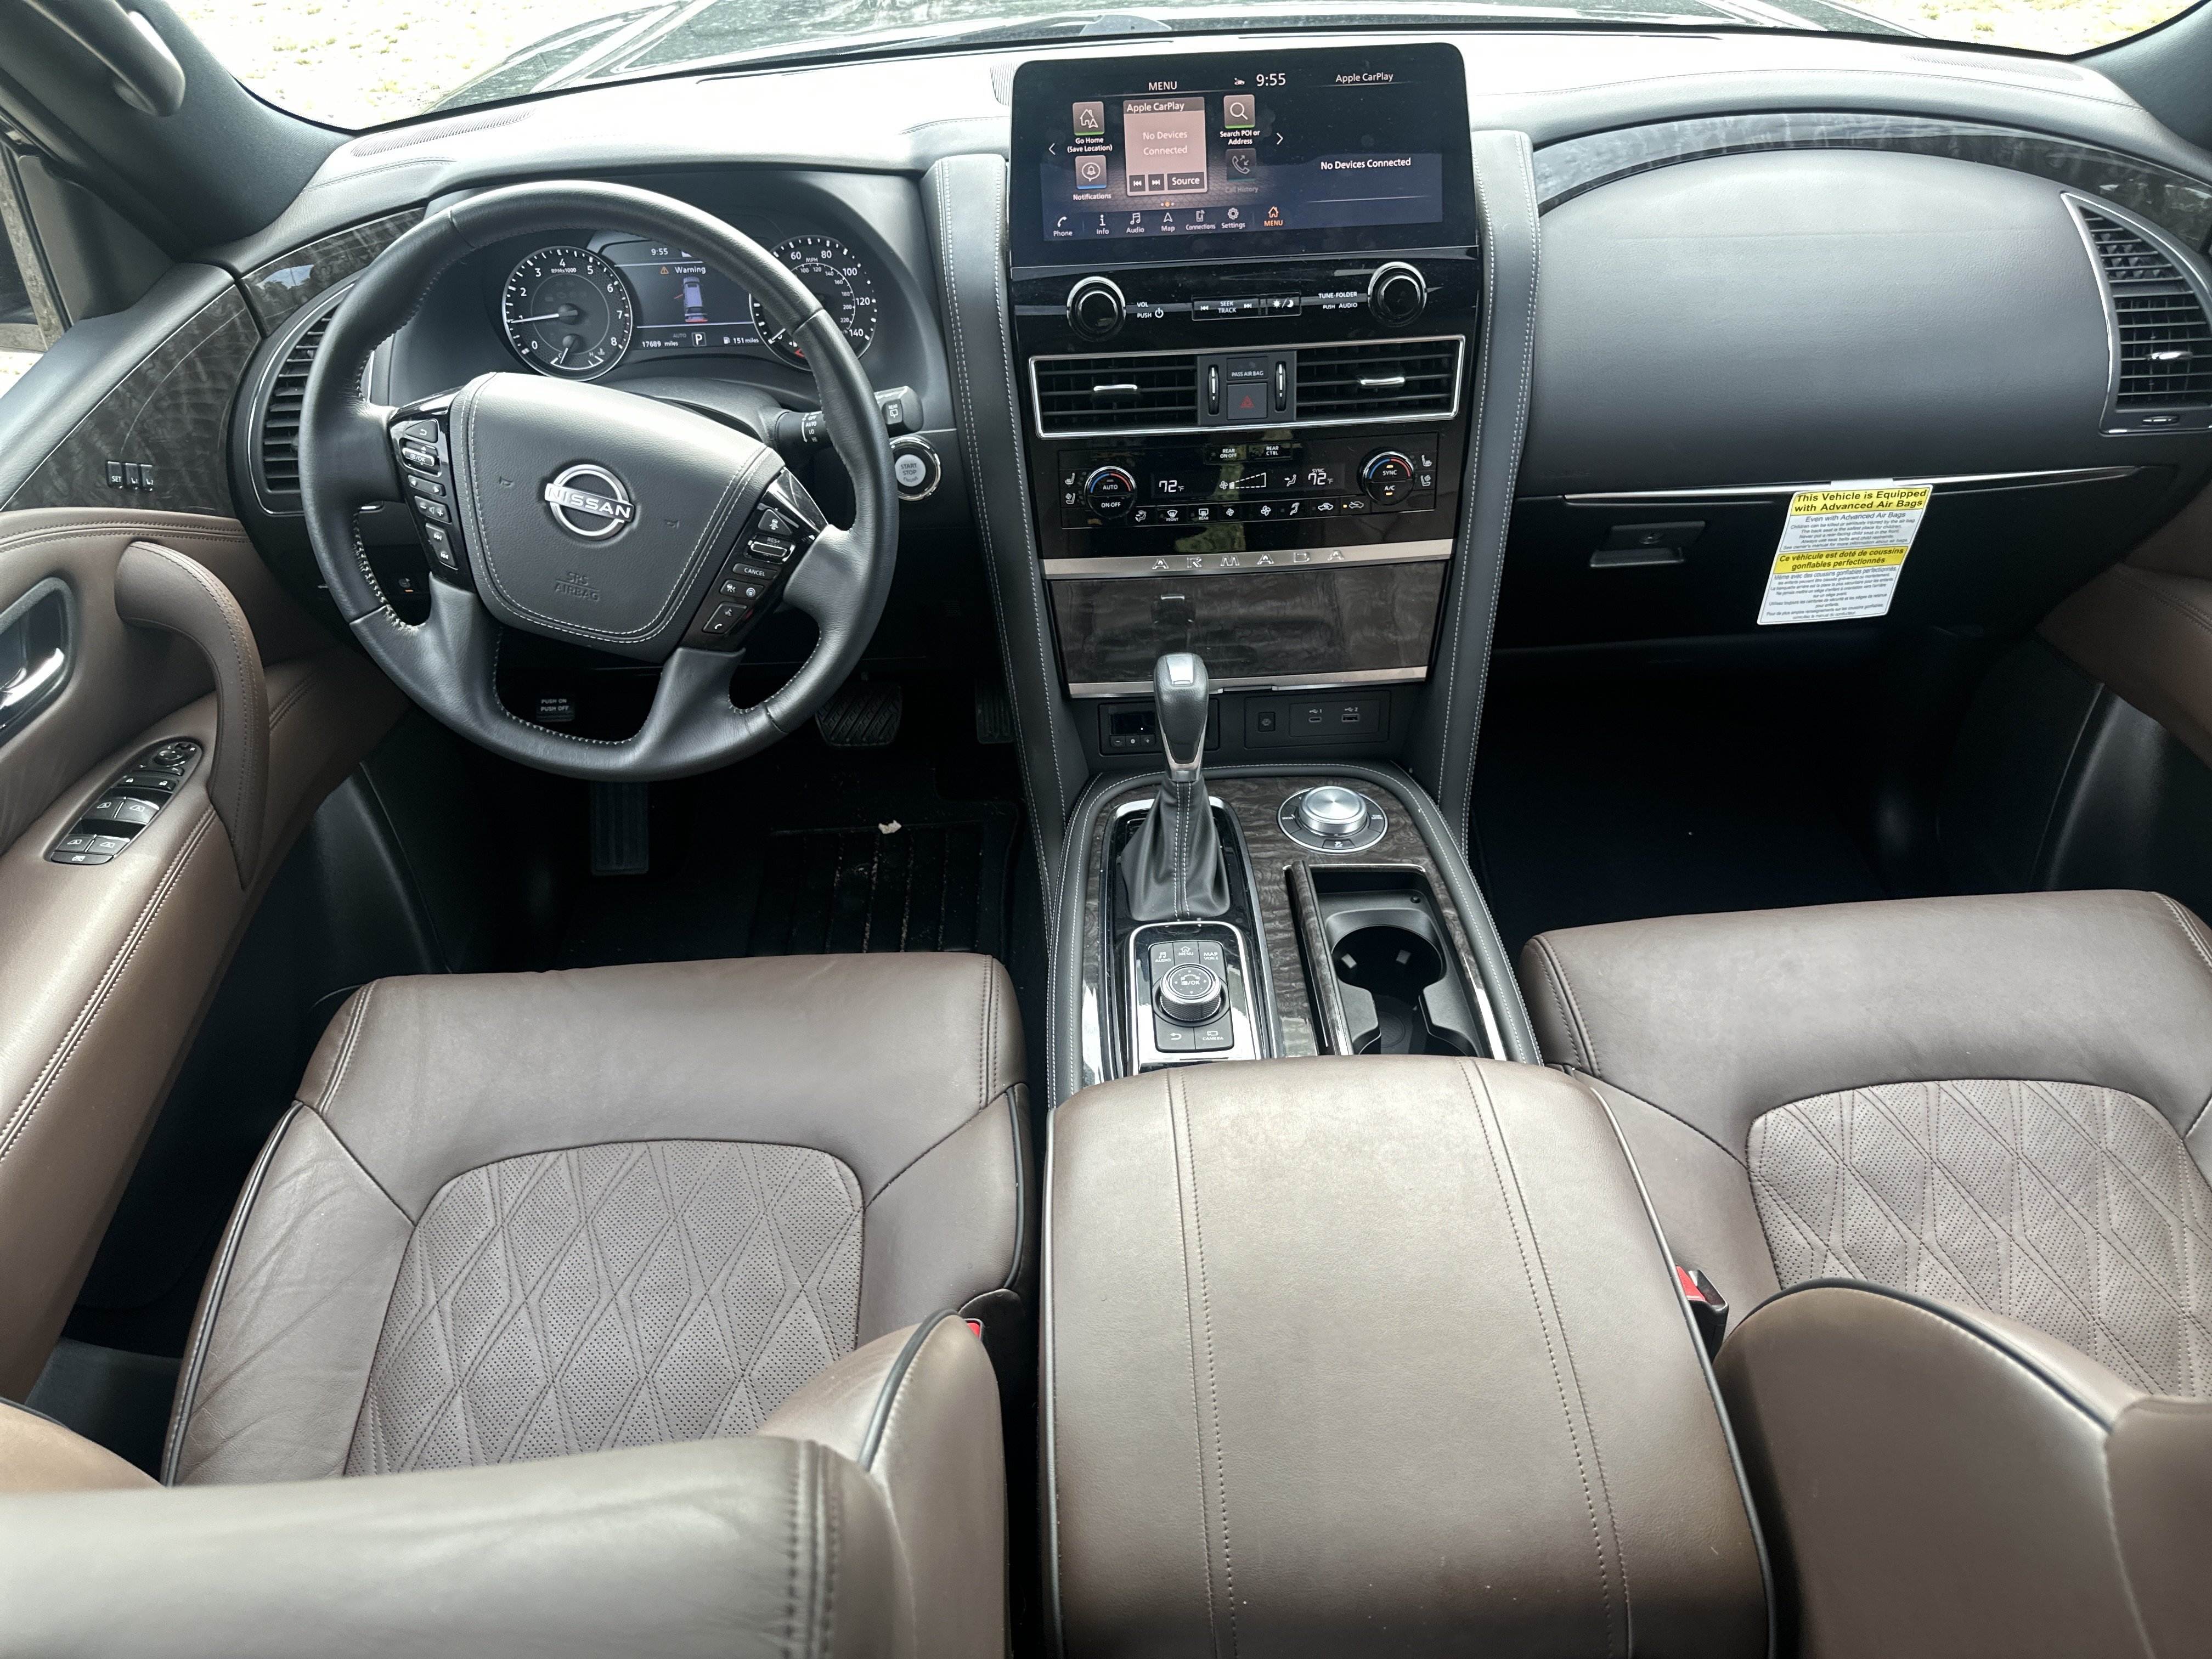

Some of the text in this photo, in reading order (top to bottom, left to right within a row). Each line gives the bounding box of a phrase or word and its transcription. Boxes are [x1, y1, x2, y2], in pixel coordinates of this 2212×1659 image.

[1256, 73, 1286, 86] 9:55
[1335, 72, 1393, 83] Apple CarPlay
[1148, 81, 1177, 91] MENU
[1126, 101, 1184, 113] Apple CarPlay
[1321, 158, 1410, 170] No Devices Connected
[1172, 177, 1200, 185] Source
[791, 251, 801, 259] 60
[560, 258, 566, 267] 4
[535, 268, 541, 276] 3
[587, 266, 594, 274] 5
[675, 266, 706, 274] Warning
[843, 268, 857, 276] 100
[520, 287, 527, 296] 2
[607, 284, 613, 292] 6
[617, 311, 622, 319] 7
[611, 337, 617, 346] 8
[695, 334, 702, 345] P
[532, 341, 538, 349] 0
[1822, 493, 1860, 501] Vehicle
[1876, 489, 1927, 499] Equipped
[549, 488, 631, 518] NISSAN
[1820, 501, 1874, 511] Advanced
[1896, 500, 1922, 508] Bags
[1152, 550, 1345, 569] ARMADA
[1791, 557, 1885, 571] gonflables perfectionnés
[744, 568, 765, 577] CANCEL
[568, 572, 589, 585] SRS
[555, 583, 600, 602] AIRBAG
